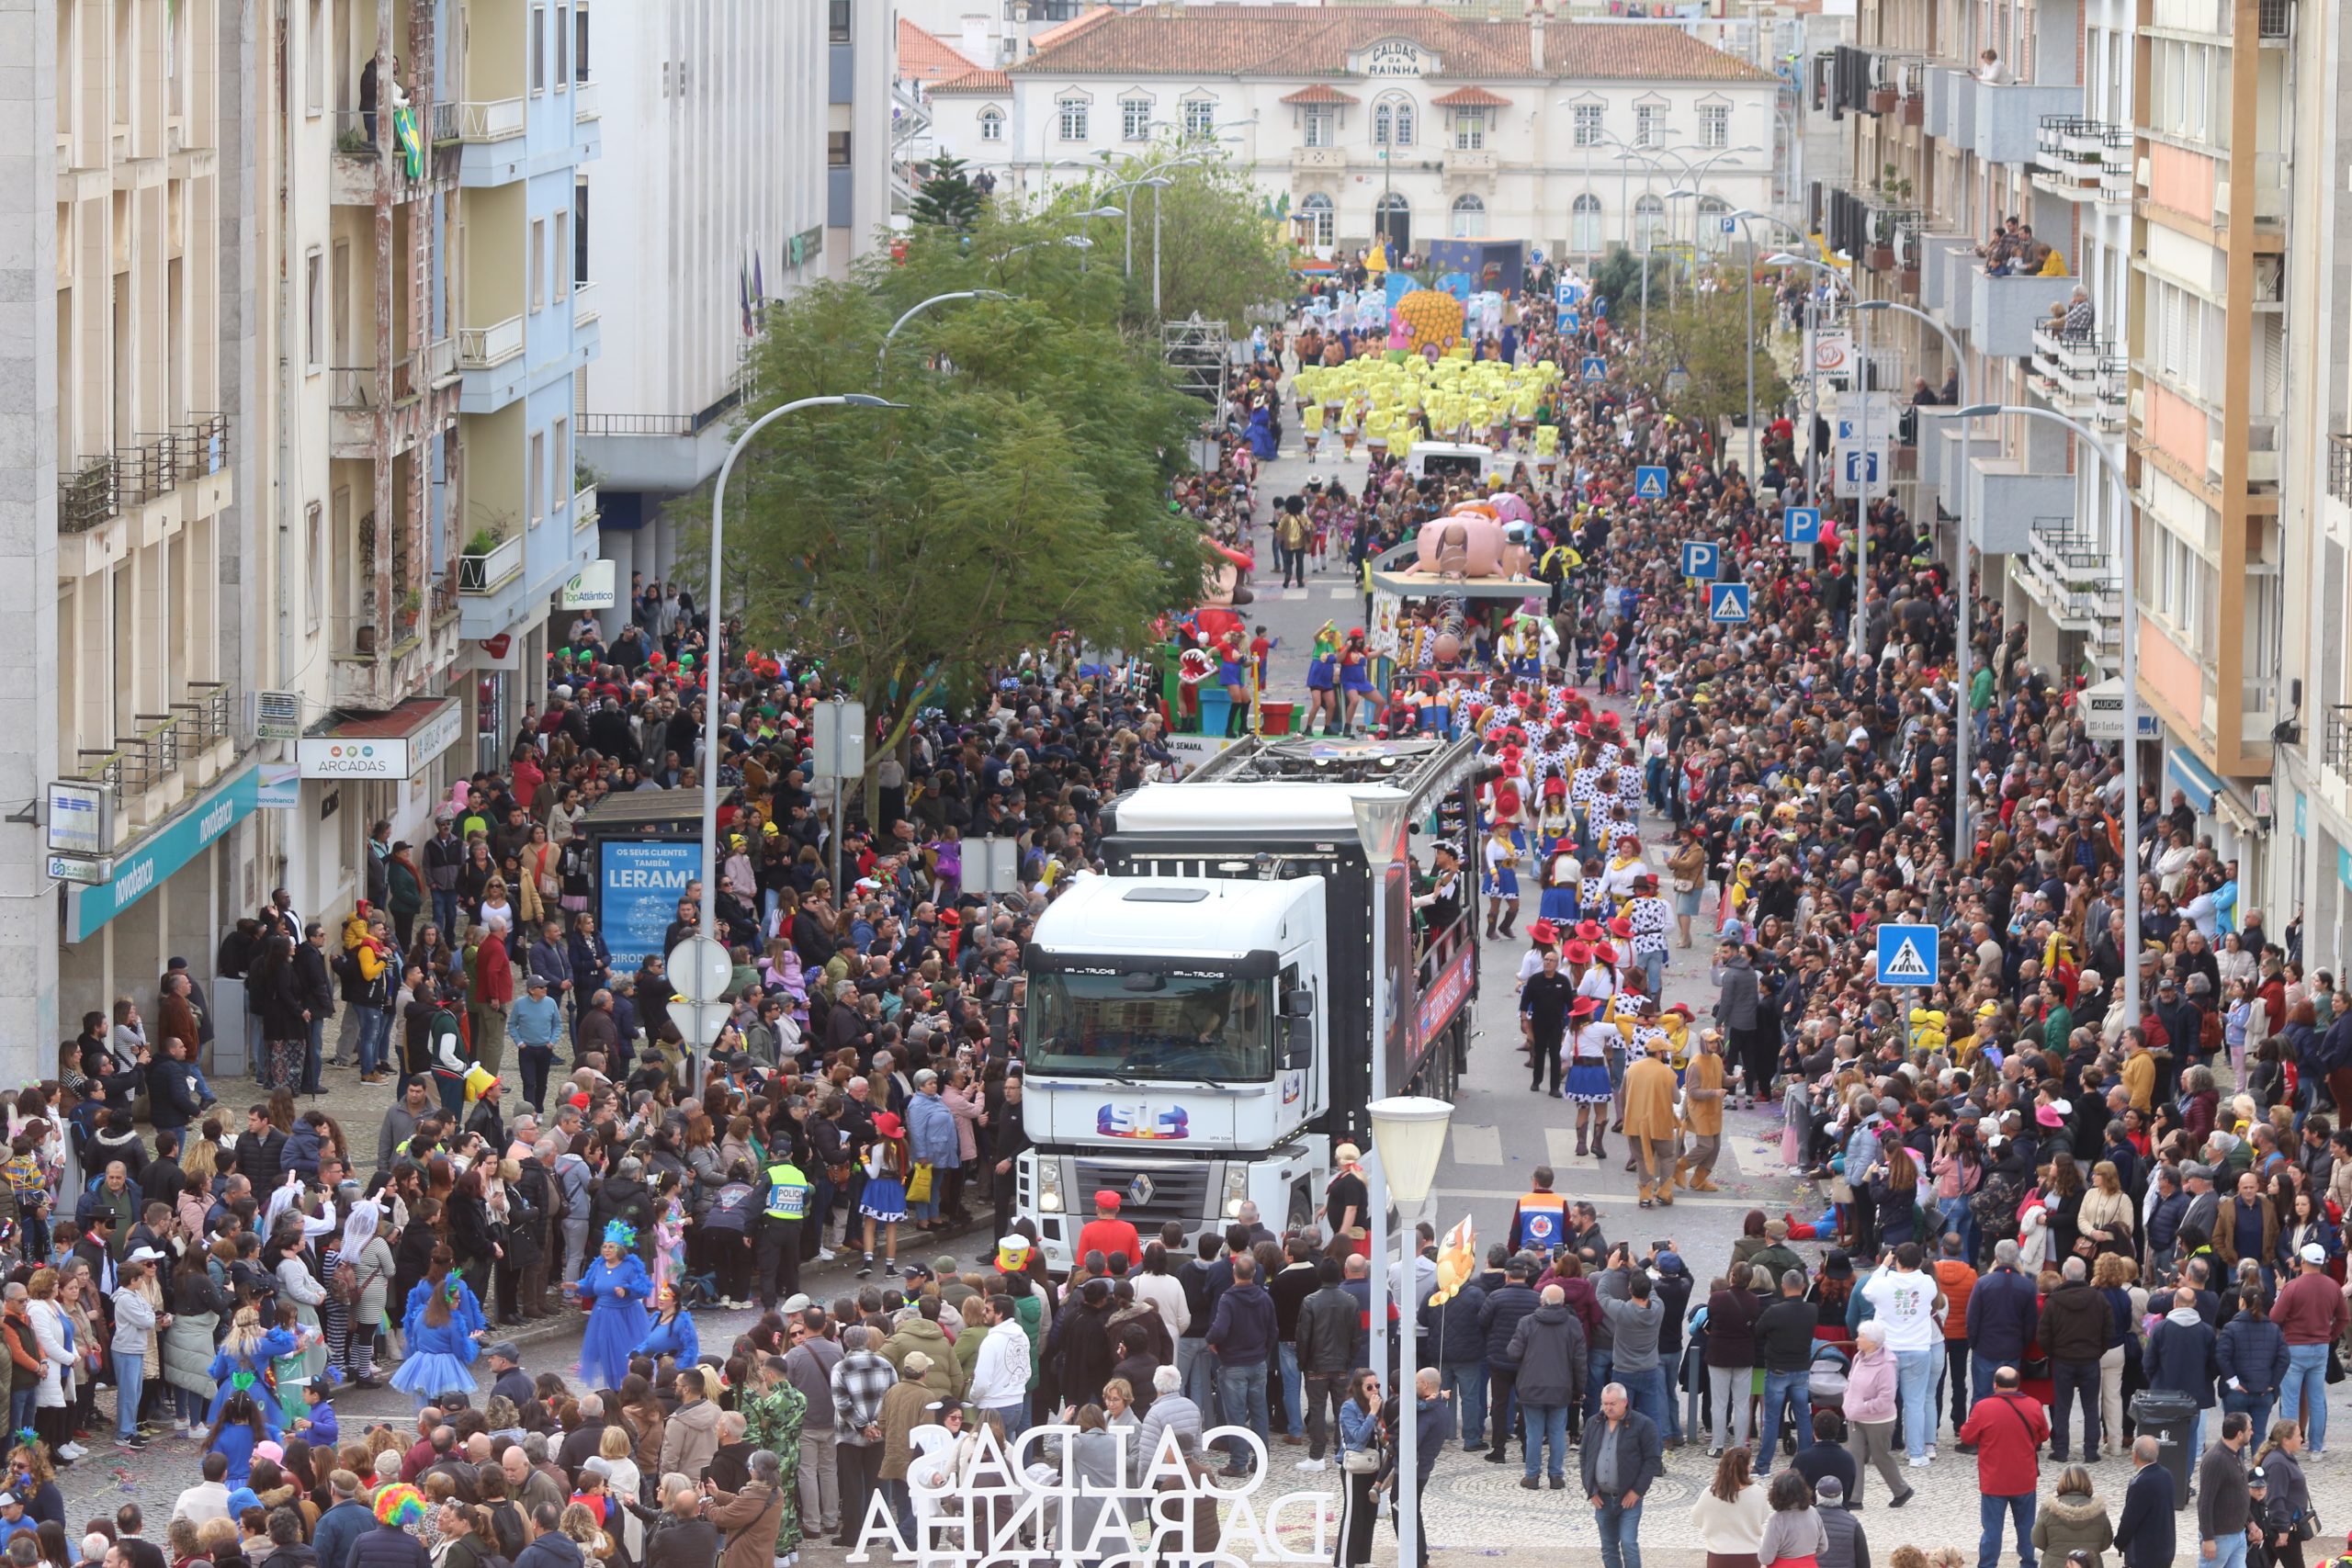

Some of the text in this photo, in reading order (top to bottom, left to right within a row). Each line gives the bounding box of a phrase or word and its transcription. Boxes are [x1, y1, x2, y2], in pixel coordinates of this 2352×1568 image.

[1373, 43, 1417, 62] CALDAS
[1369, 65, 1420, 74] RAINHA
[1559, 287, 1571, 303] P
[1792, 512, 1812, 539] P
[1690, 546, 1711, 574] P
[564, 591, 614, 604] TopAtlântico
[2093, 701, 2125, 709] AUDIO
[2089, 720, 2125, 731] McIntos
[318, 761, 387, 772] ARCADAS
[199, 798, 233, 844] novobanco
[634, 858, 670, 867] TAMBÉM
[115, 857, 153, 908] novobanco
[1084, 967, 1115, 976] TRUCKS
